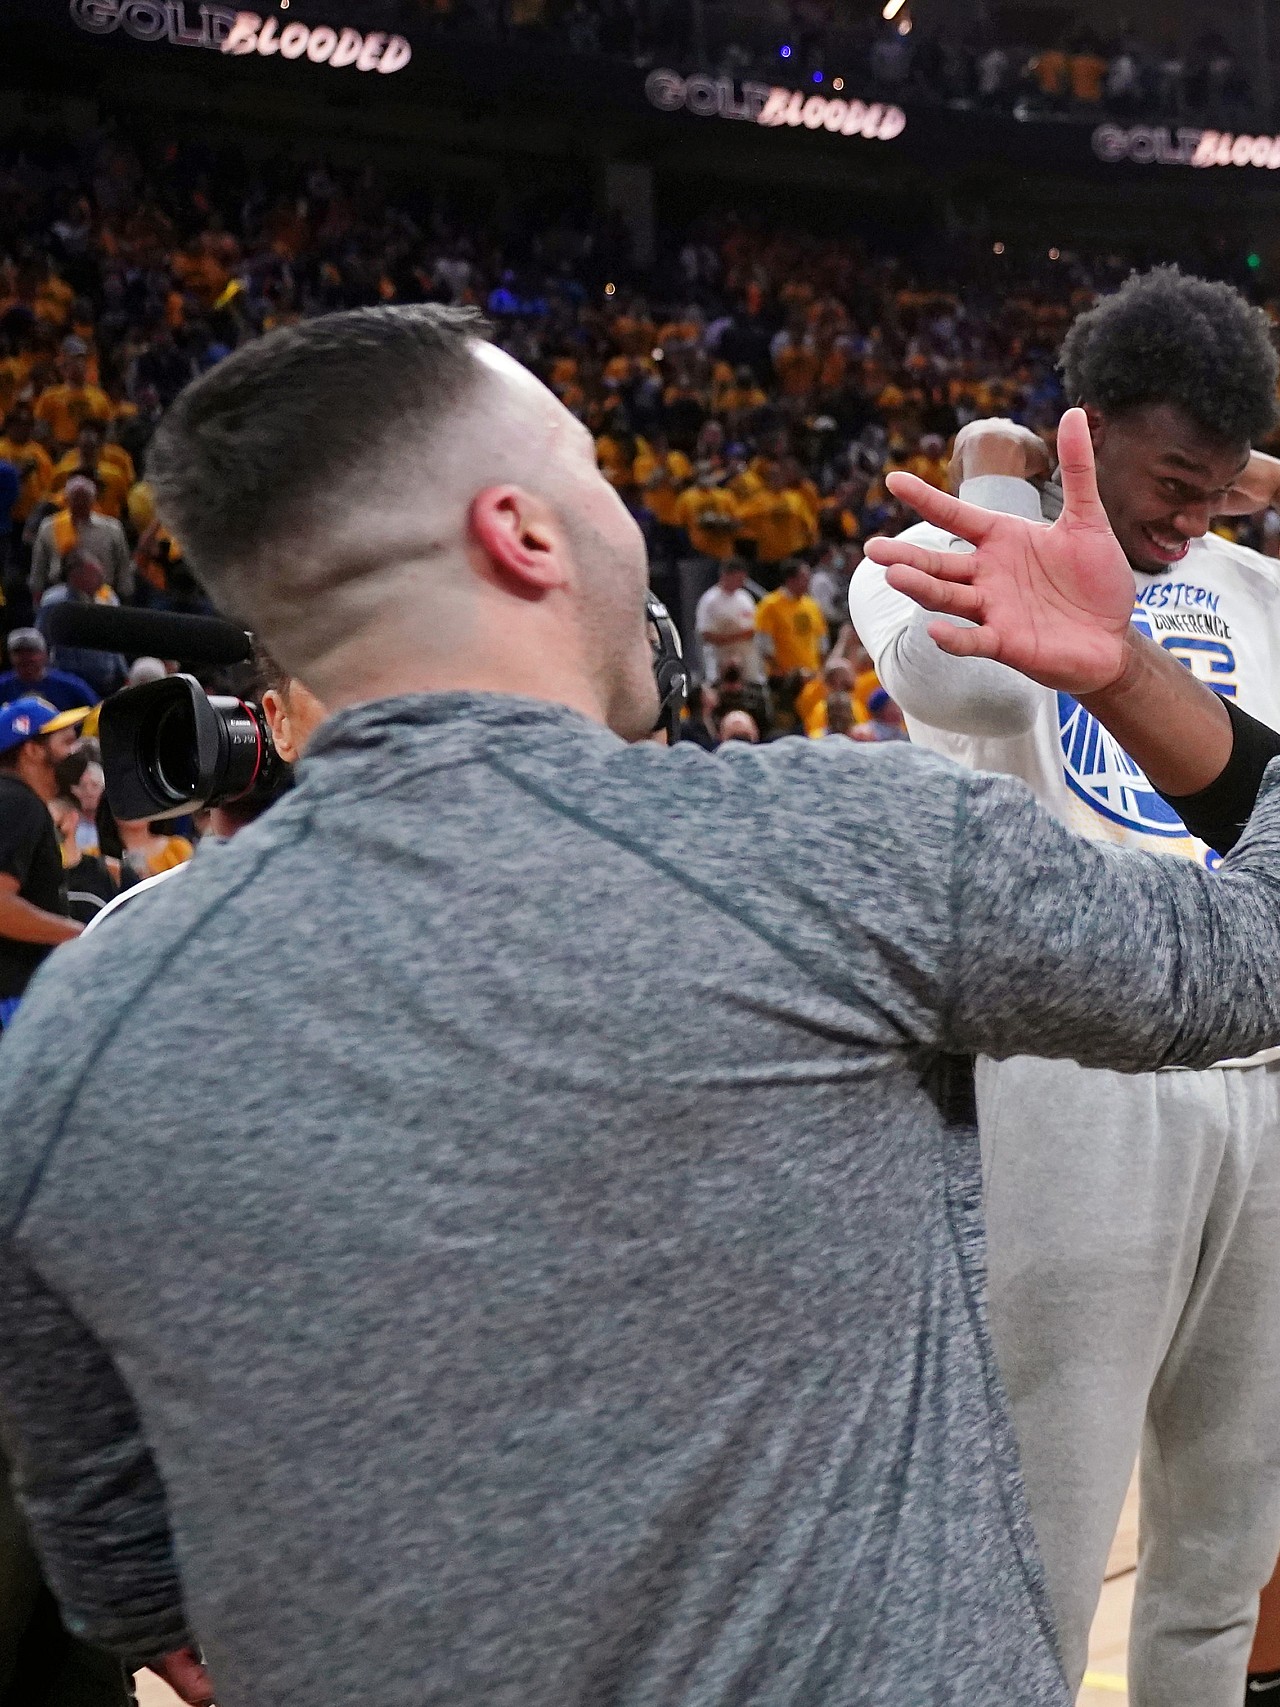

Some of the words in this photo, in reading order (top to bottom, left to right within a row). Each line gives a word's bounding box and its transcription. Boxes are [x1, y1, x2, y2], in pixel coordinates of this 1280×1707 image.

[221, 11, 412, 74] BLOODED
[757, 86, 906, 141] BLOODED
[1152, 612, 1232, 639] CONFERENCE
